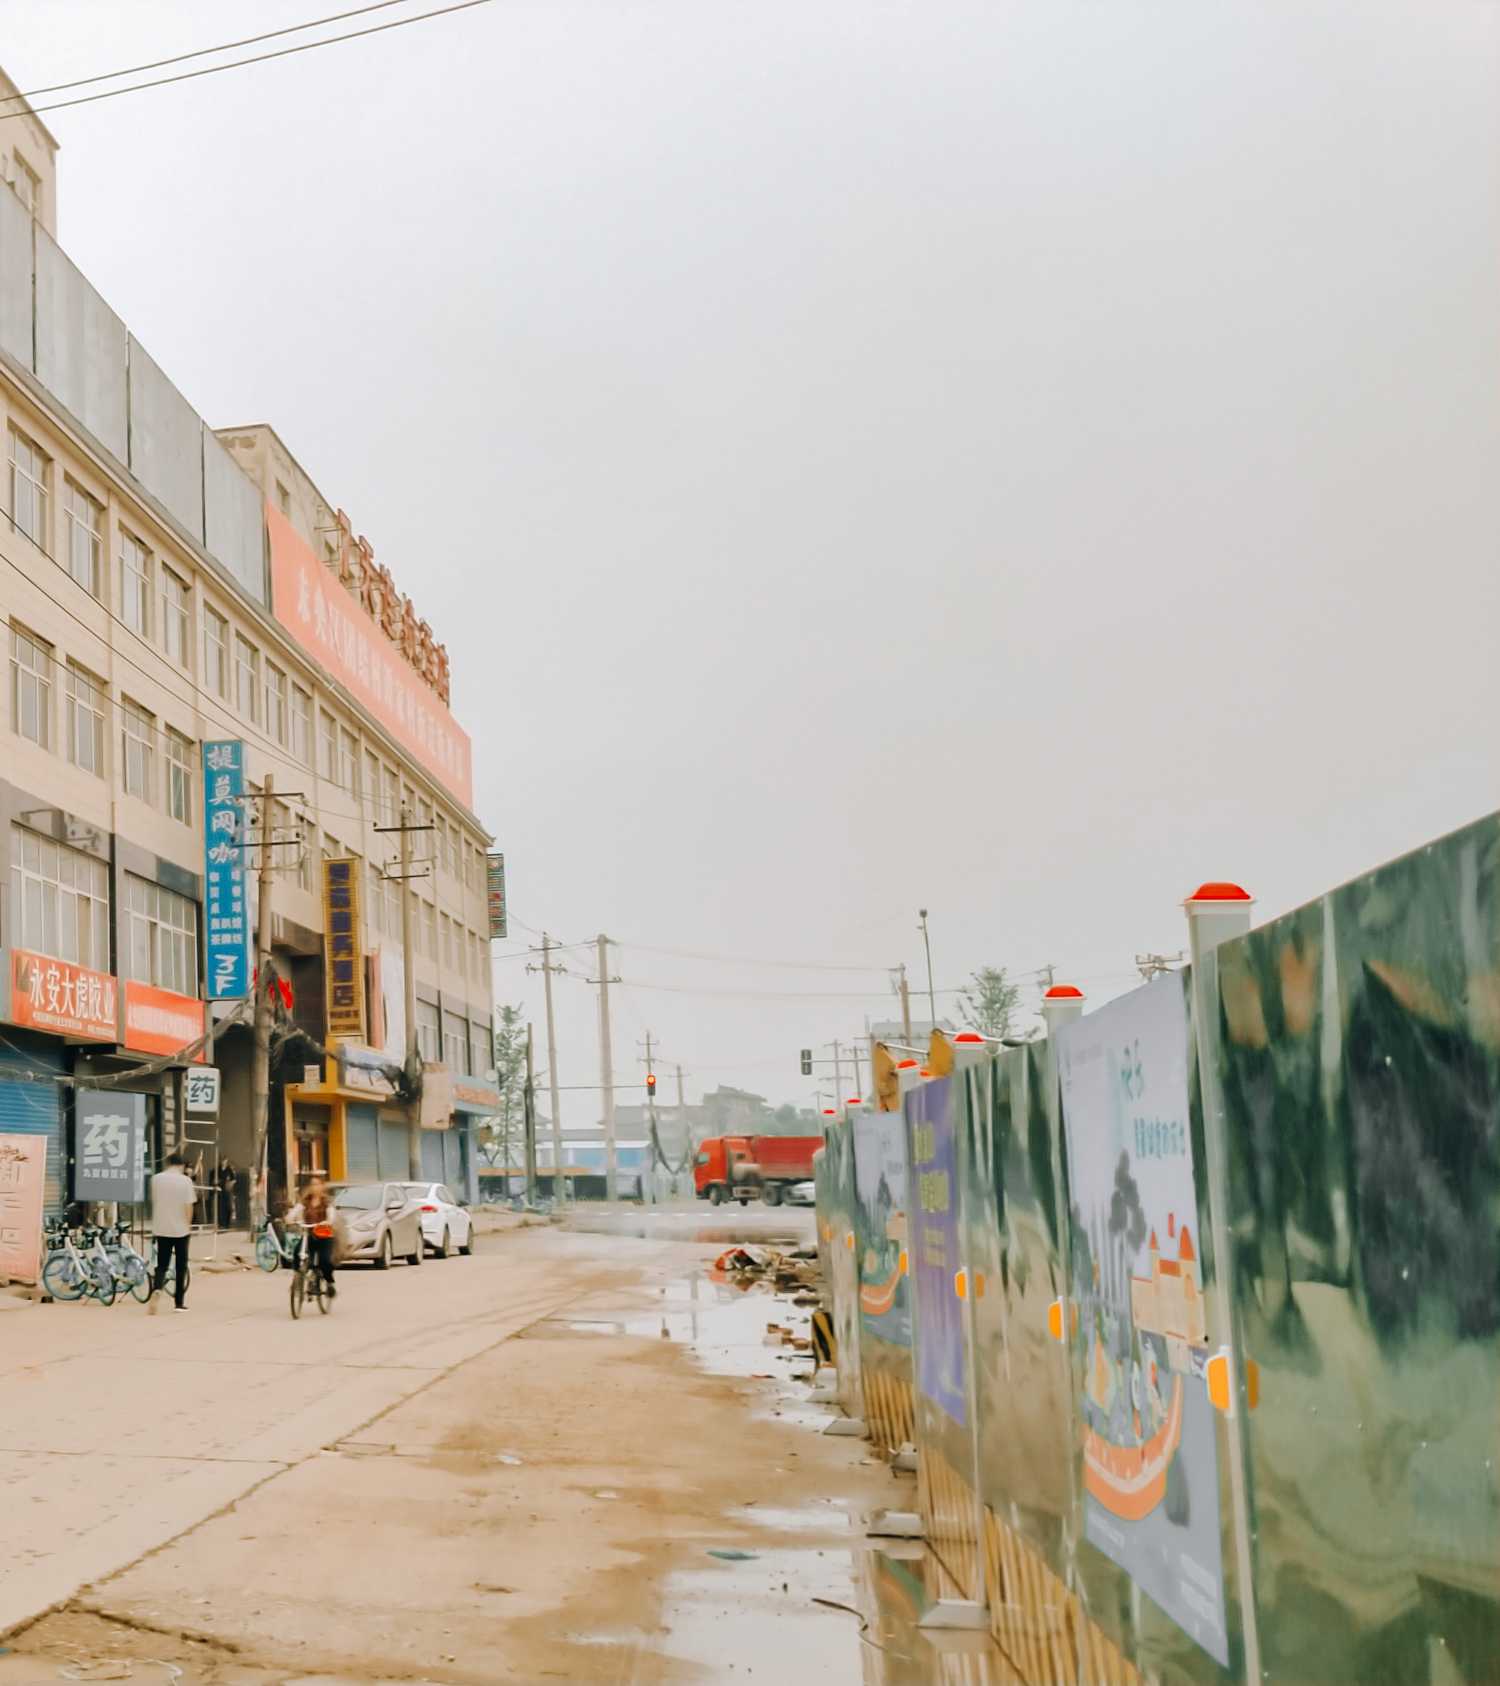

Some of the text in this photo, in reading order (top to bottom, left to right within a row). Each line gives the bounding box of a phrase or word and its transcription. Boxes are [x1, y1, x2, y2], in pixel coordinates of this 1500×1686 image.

[206, 744, 240, 865] 提莫网咖
[188, 1074, 216, 1105] 药
[82, 1114, 130, 1168] 药
